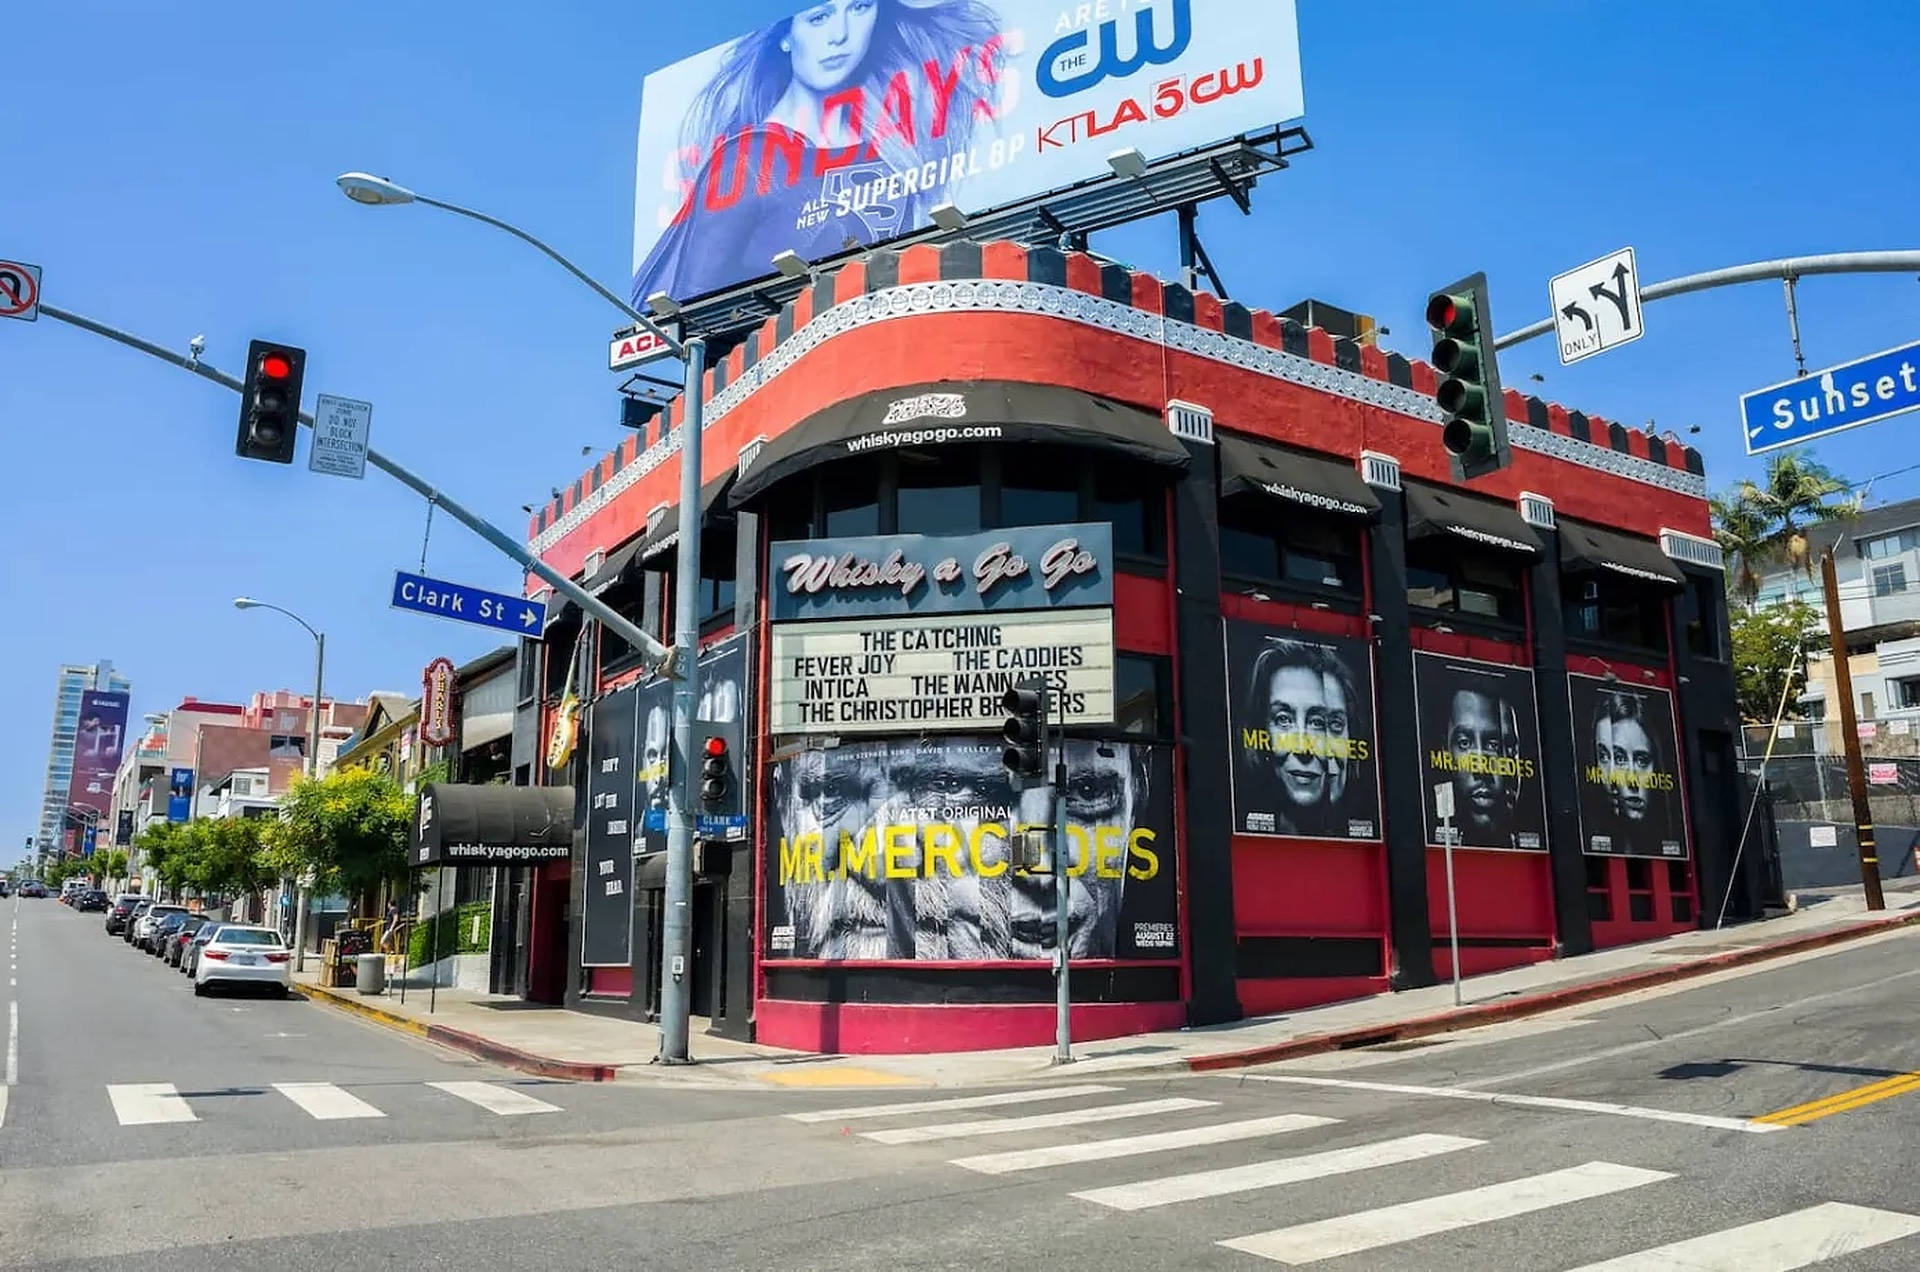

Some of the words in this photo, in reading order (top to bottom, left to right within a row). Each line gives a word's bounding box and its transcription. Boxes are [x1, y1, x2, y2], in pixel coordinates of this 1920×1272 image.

[1036, 0, 1192, 98] CW
[1060, 53, 1087, 72] THE
[656, 29, 1025, 228] SUNDAYS
[1038, 98, 1148, 154] KTLA
[1154, 78, 1184, 118] 5
[836, 148, 982, 218] SUPERGIRL
[796, 208, 830, 230] NEW
[801, 199, 829, 215] ALL
[1564, 333, 1597, 356] ONLY
[1772, 361, 1917, 430] Sunset
[847, 426, 1002, 452] whiskyagogo.com
[783, 549, 925, 595] Whisky
[932, 557, 962, 581] a
[972, 541, 1029, 594] Go
[1039, 537, 1098, 590] Go
[401, 581, 464, 612] Clark
[479, 599, 505, 621] St
[860, 631, 897, 652] THE
[902, 626, 1002, 650] CATCHING
[794, 655, 852, 678] FEVER
[858, 653, 896, 676] JOY
[953, 650, 990, 672] THE
[997, 645, 1083, 669] CADDIES
[805, 677, 870, 700] INTICA
[911, 674, 949, 697] THE
[798, 702, 835, 724] THE
[840, 697, 973, 722] CHRISTOPHER
[979, 692, 1085, 717] BRERS
[899, 807, 937, 821] AT&T
[942, 806, 1013, 821] ORIGINAL
[448, 843, 569, 859] whiskyagogo.com
